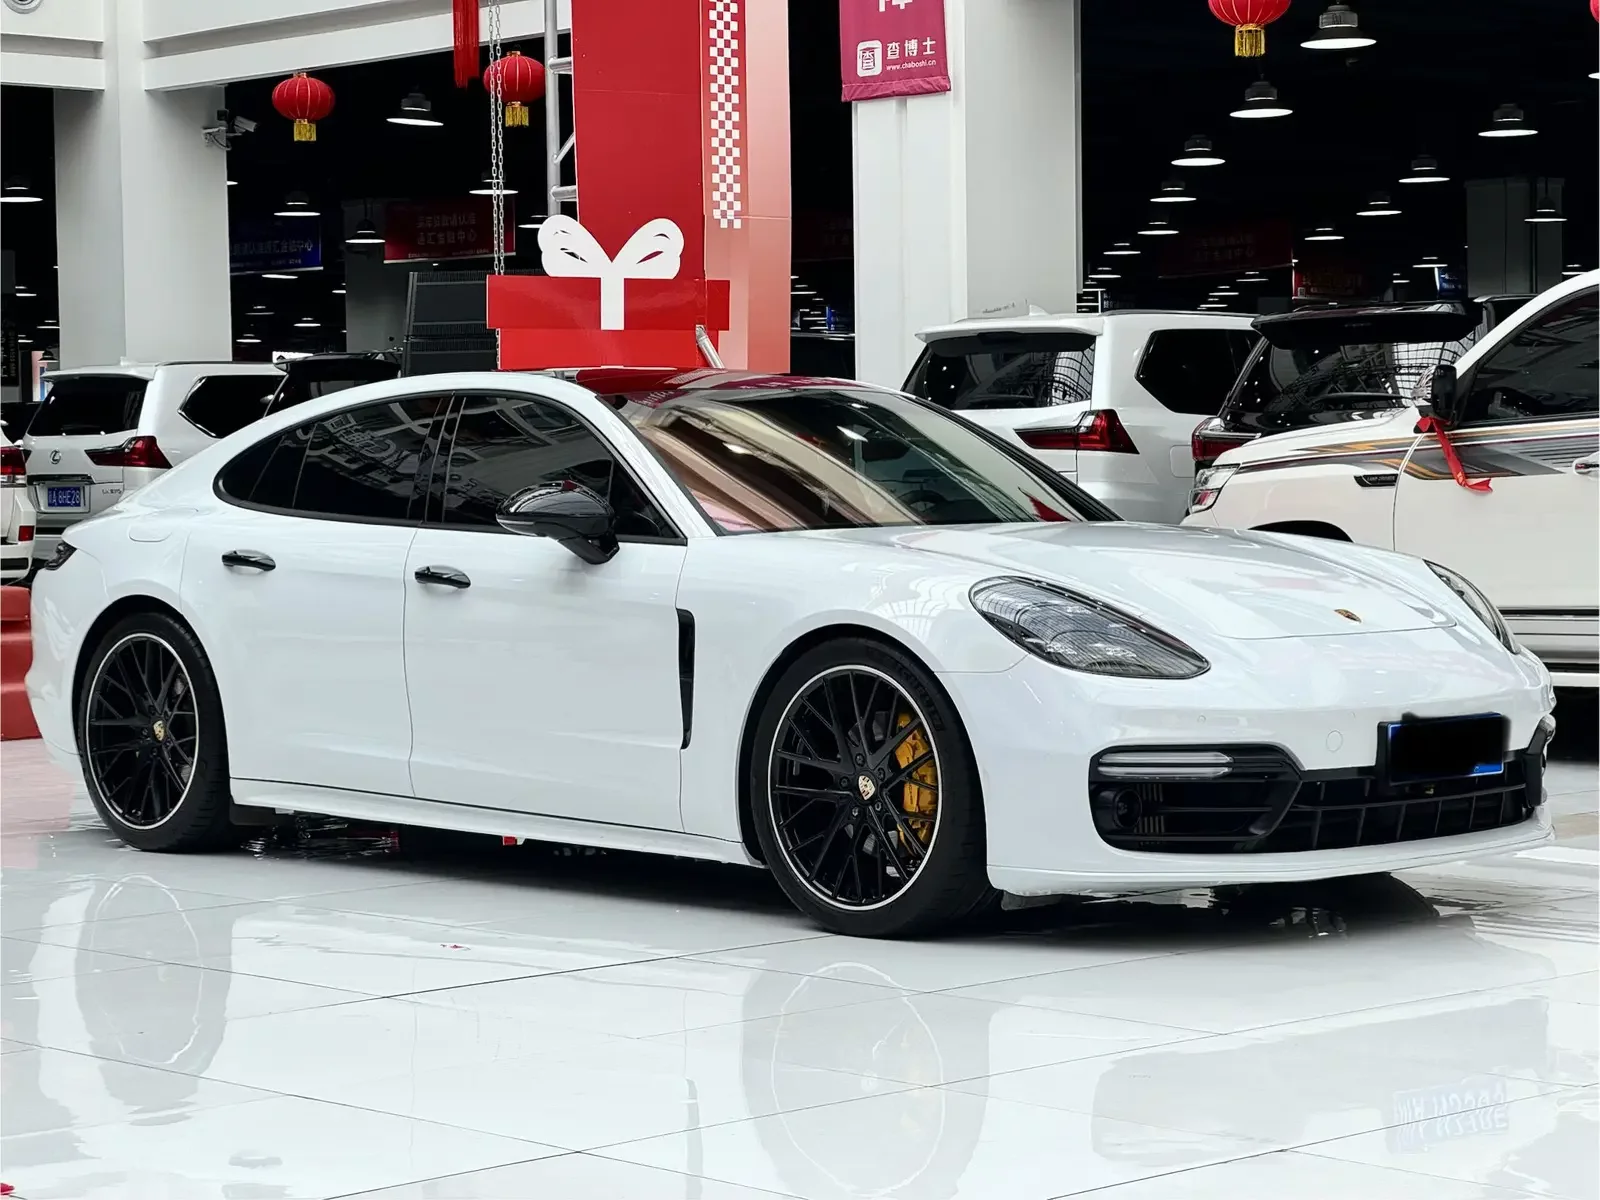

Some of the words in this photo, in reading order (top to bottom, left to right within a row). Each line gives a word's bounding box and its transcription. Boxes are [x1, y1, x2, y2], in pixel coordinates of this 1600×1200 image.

[886, 37, 936, 60] 查博士
[886, 59, 936, 71] www.chaboshi.cn
